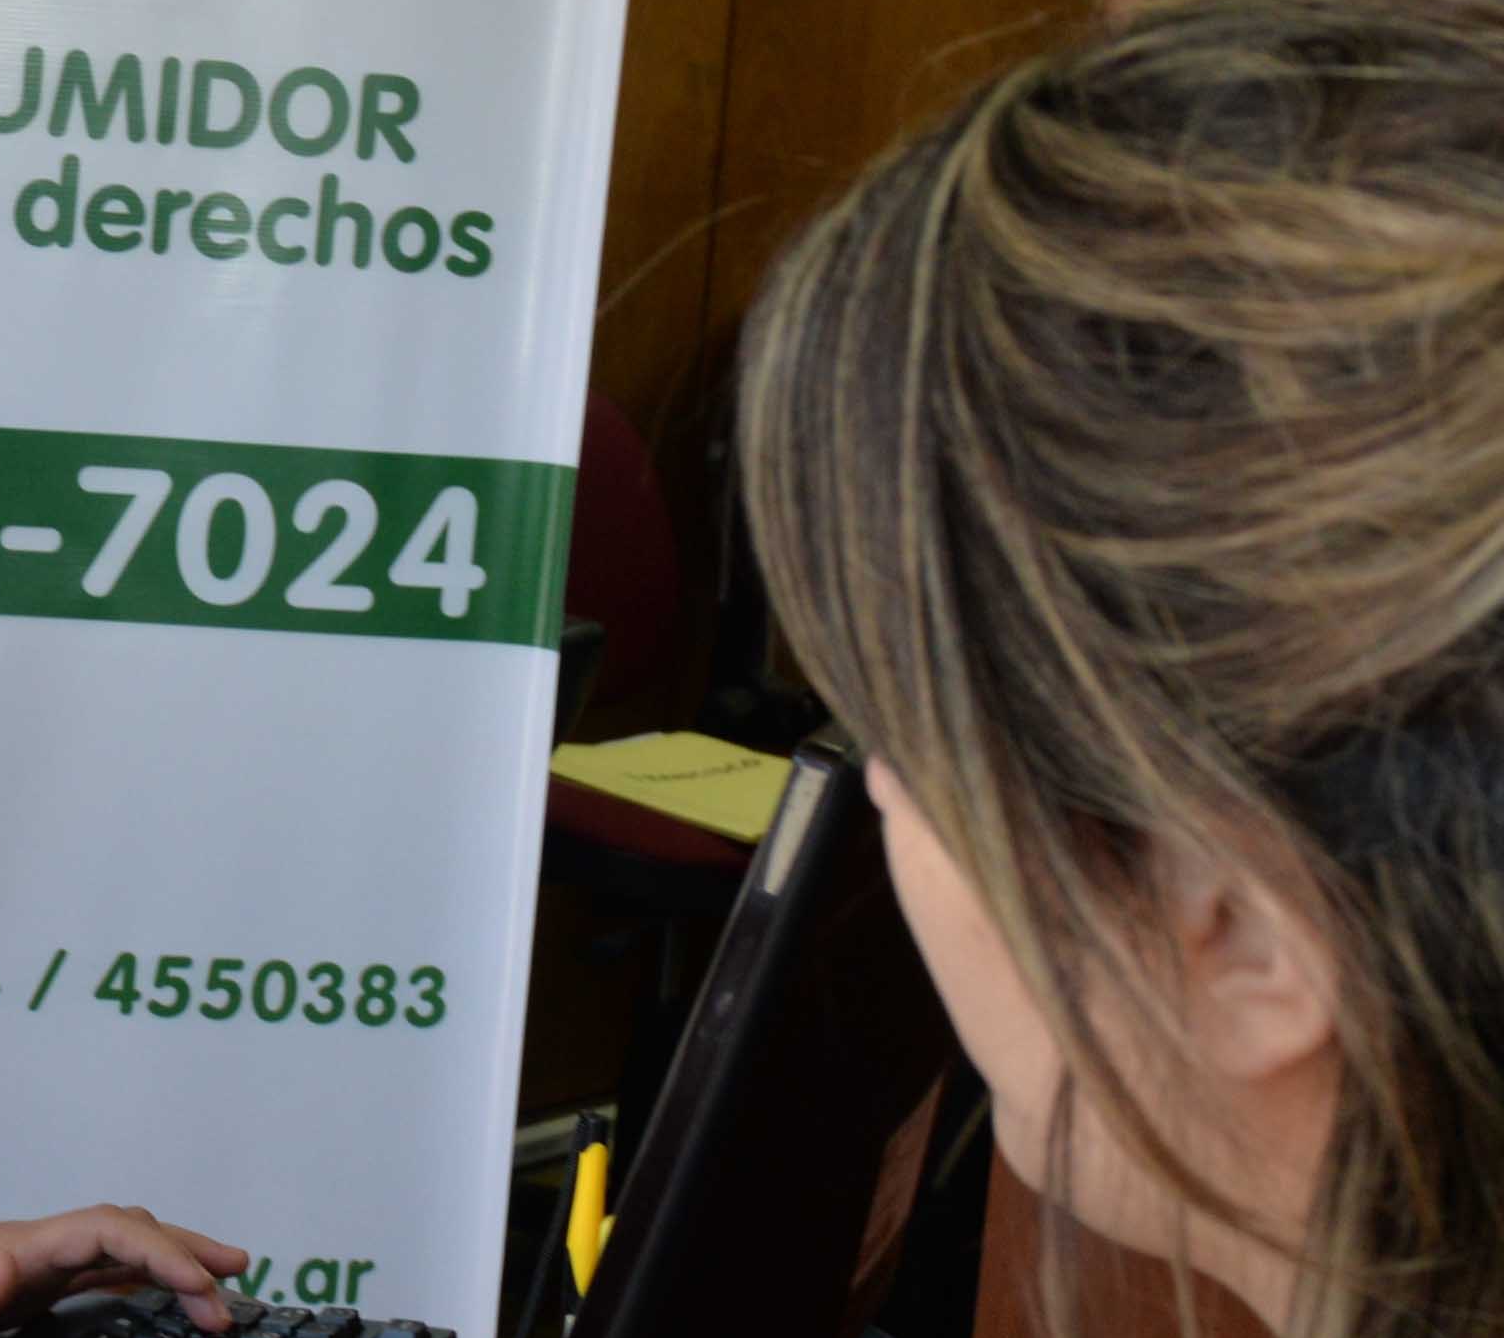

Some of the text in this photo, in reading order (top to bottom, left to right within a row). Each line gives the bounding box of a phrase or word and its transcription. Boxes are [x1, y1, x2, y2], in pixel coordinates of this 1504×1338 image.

[15, 146, 496, 277] derechos
[27, 949, 70, 1011] /
[95, 954, 448, 1029] 4550383
